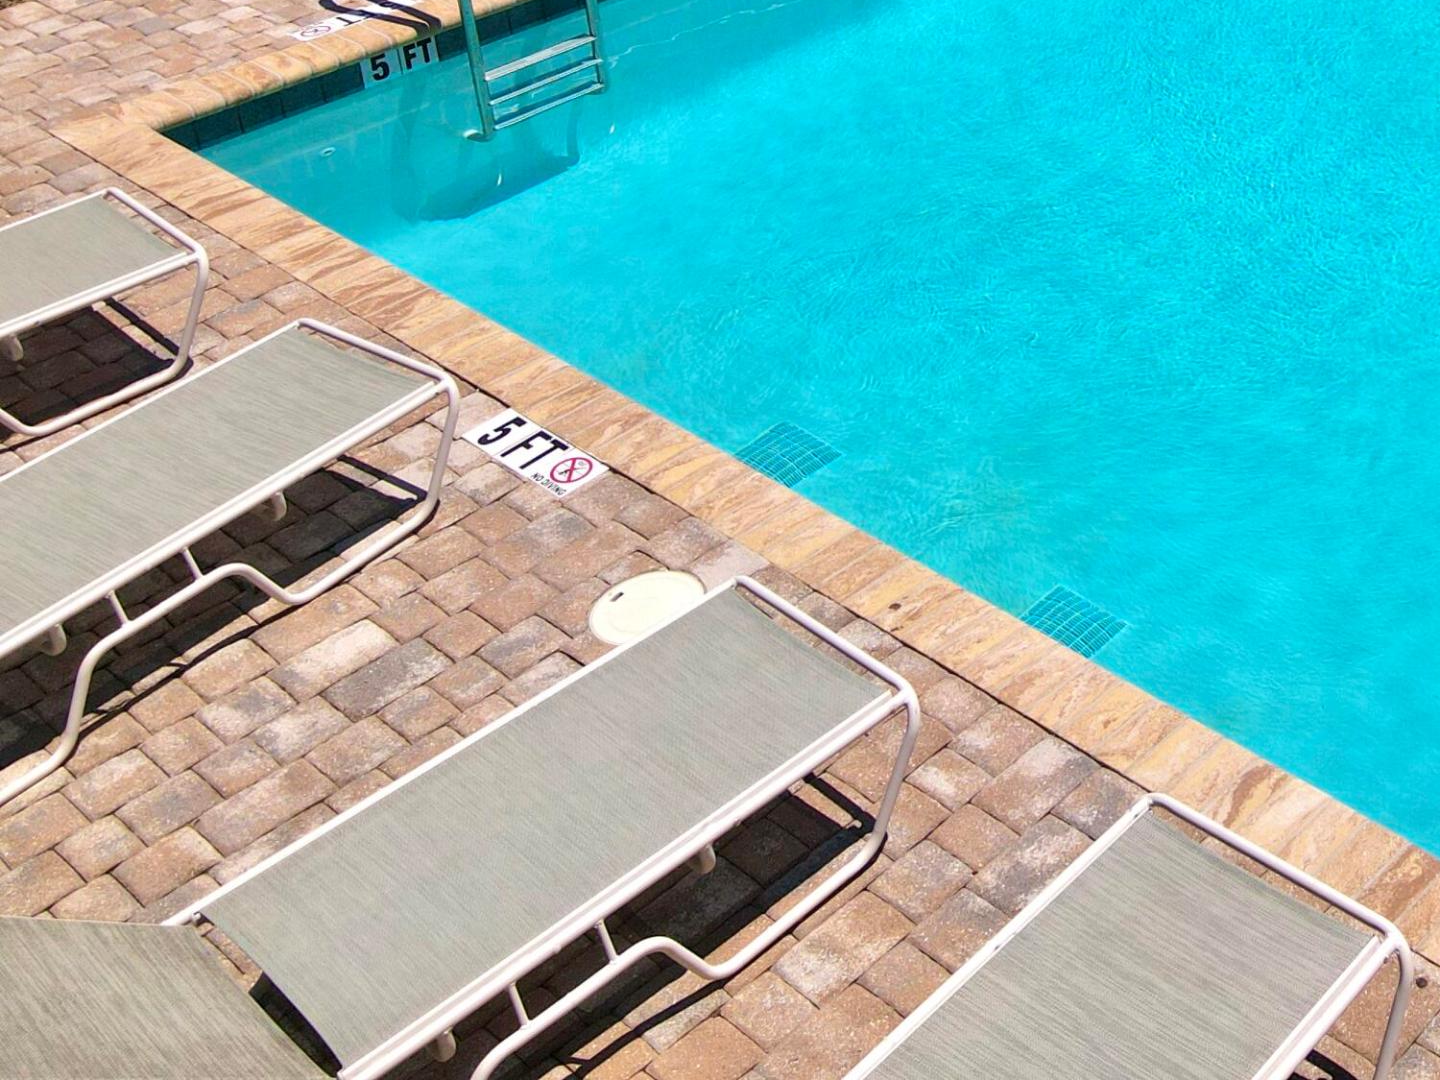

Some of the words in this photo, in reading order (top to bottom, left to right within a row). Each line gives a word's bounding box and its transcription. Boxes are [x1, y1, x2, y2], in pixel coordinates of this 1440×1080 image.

[370, 54, 390, 81] 5
[403, 37, 432, 70] FT
[477, 416, 527, 445] 5
[500, 430, 569, 470] FT
[530, 472, 544, 482] NO
[540, 477, 567, 496] DIVING
